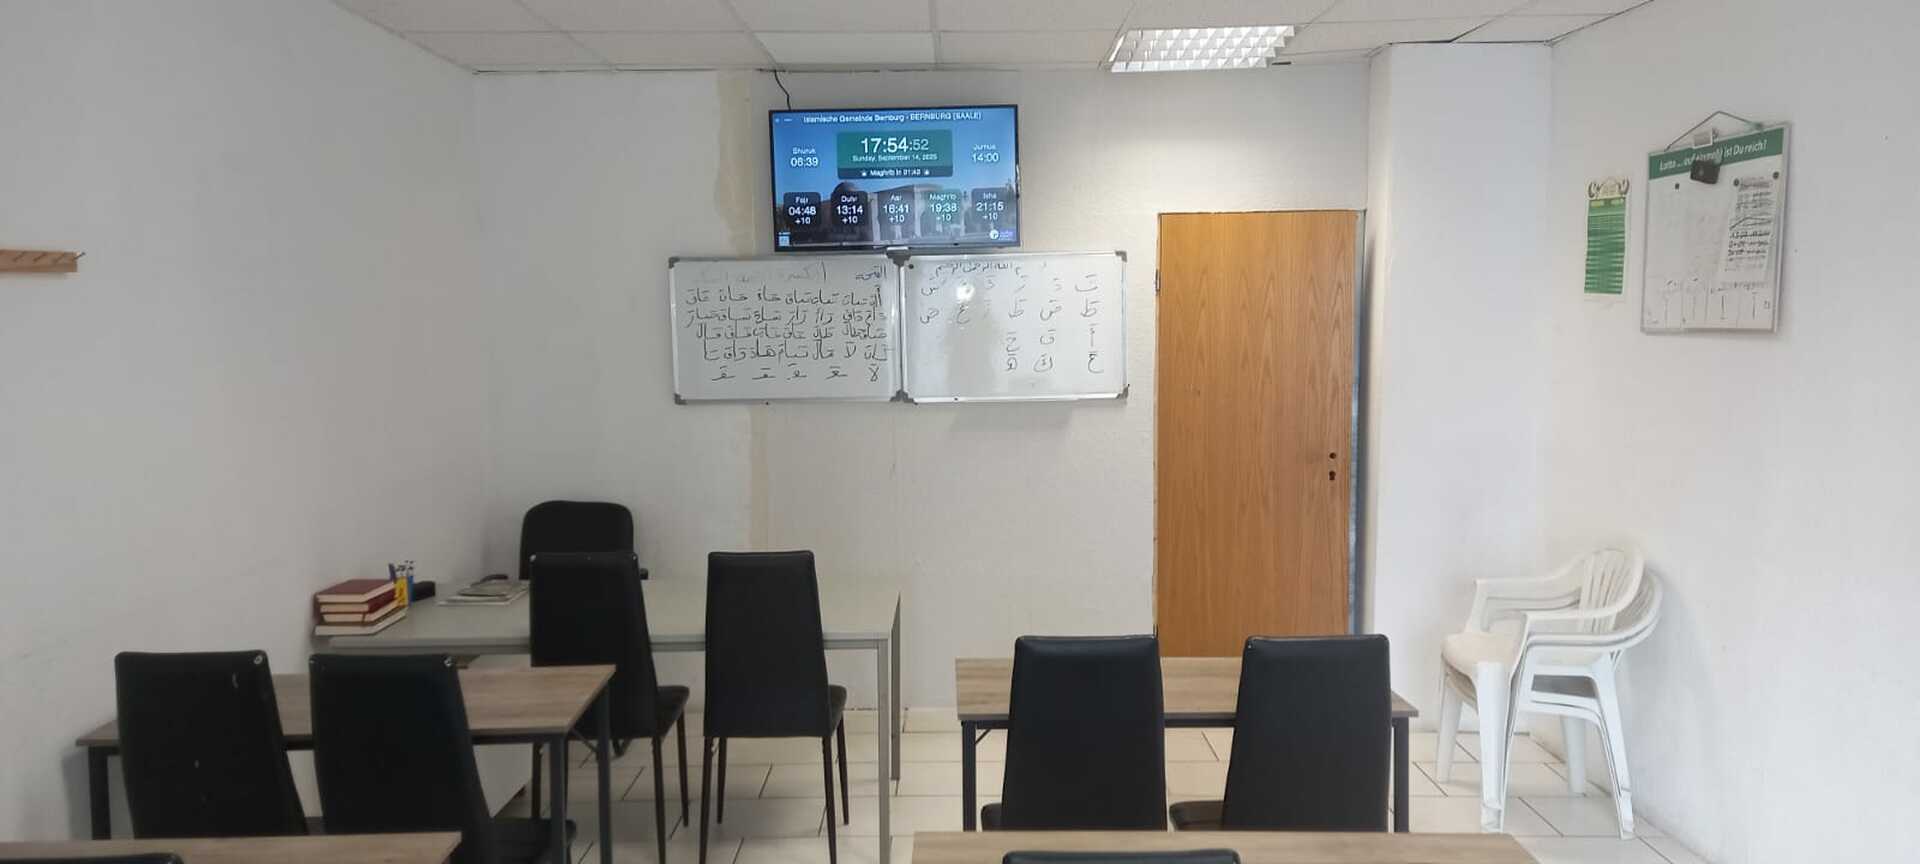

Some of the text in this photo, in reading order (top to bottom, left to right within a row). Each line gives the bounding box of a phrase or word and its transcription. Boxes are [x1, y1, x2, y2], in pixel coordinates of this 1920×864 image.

[839, 114, 873, 123] Gemeinde
[861, 137, 929, 153] 17:54:52
[790, 156, 819, 167] 06:39
[878, 154, 910, 162] September
[971, 152, 999, 162] 14:00
[929, 193, 957, 203] Maghrib
[788, 206, 817, 216] 04:48
[836, 205, 864, 215] 13:14
[883, 204, 910, 214] 16:41
[930, 203, 958, 213] 19:38
[842, 216, 858, 224] +10
[889, 215, 905, 223] +10
[936, 213, 951, 222] +10
[982, 212, 998, 221] +10
